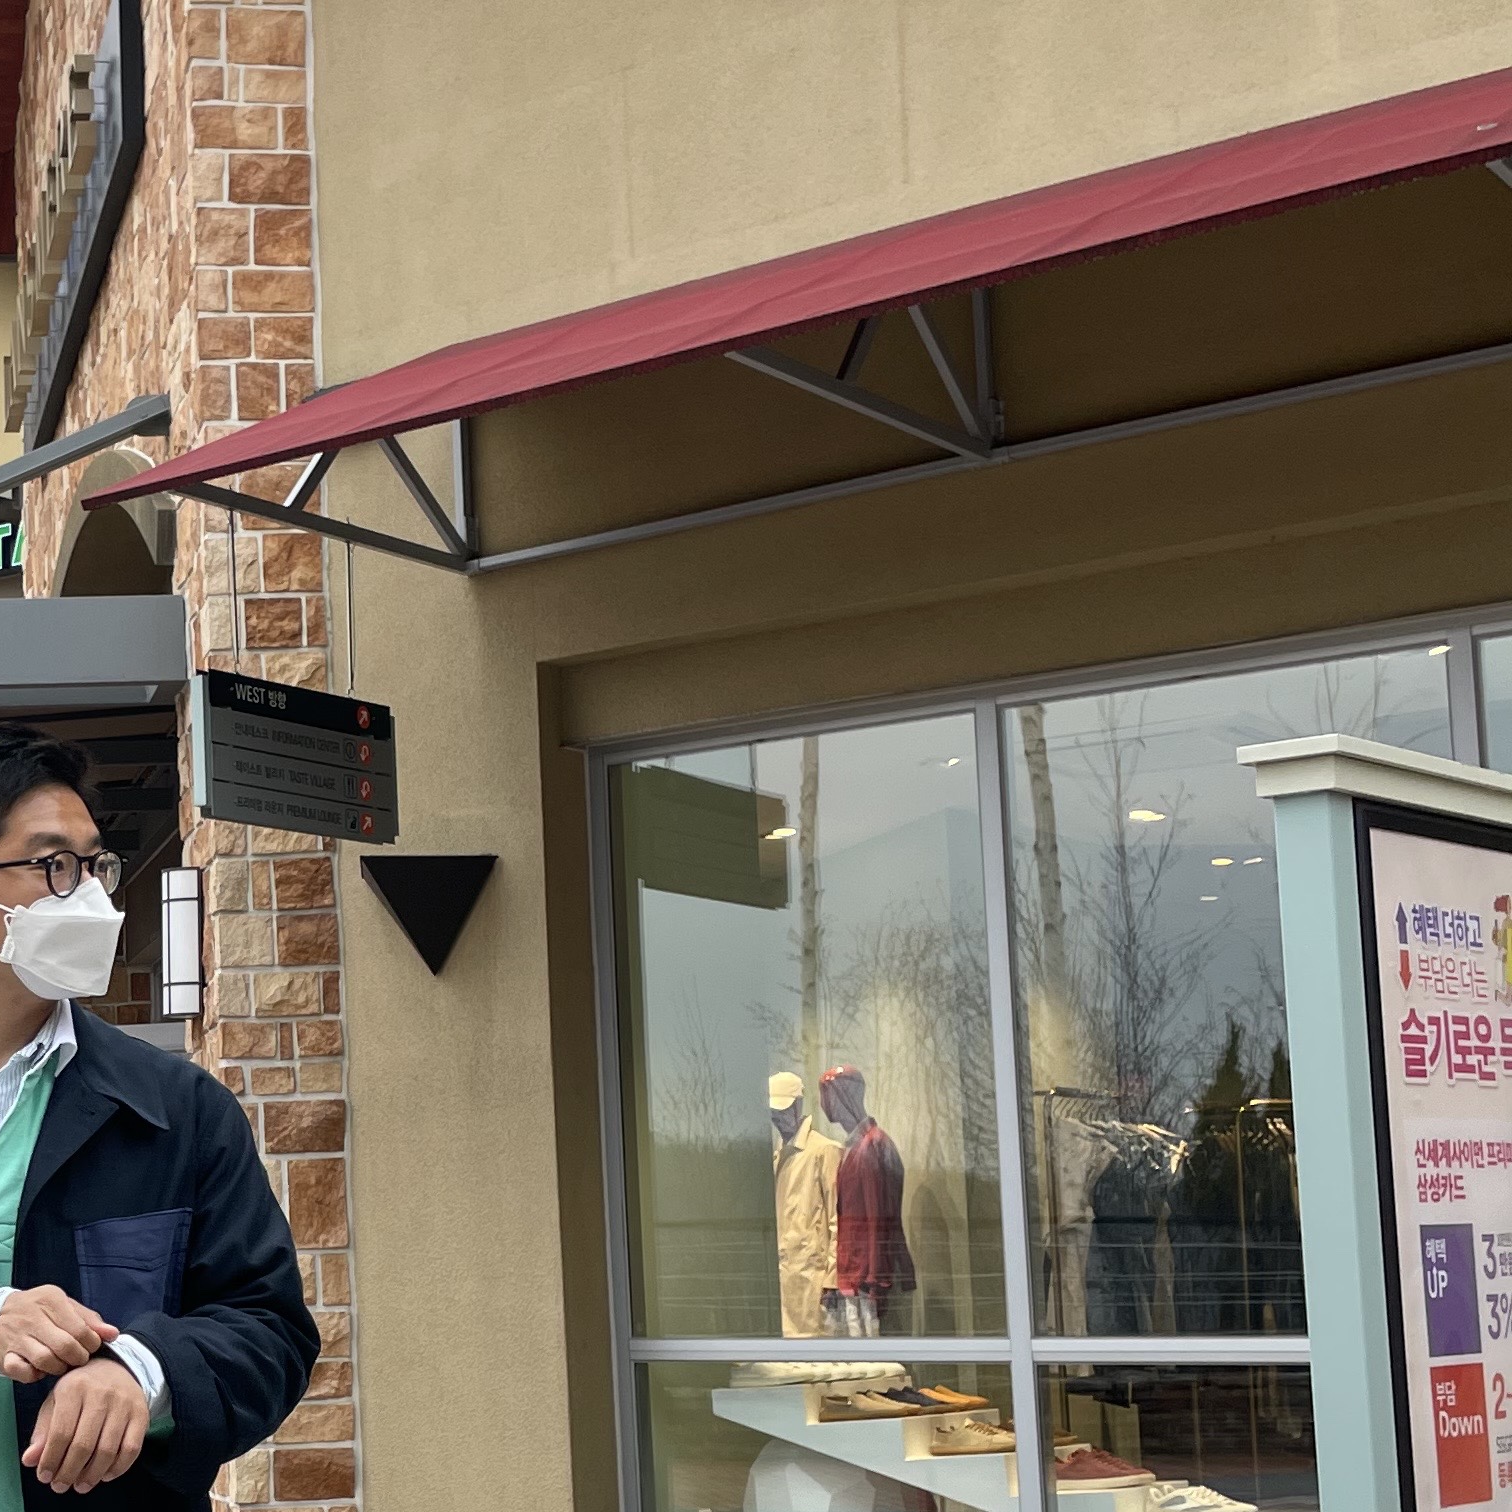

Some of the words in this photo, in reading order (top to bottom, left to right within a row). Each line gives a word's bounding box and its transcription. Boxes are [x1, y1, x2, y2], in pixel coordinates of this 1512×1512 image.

[234, 682, 266, 705] WEST
[268, 690, 287, 710] 방향
[1411, 903, 1441, 946] 혜택
[1441, 908, 1484, 950] 더하고
[1417, 954, 1459, 994] 부담은
[1460, 959, 1488, 998] 더는
[1417, 1172, 1467, 1203] 삼성카드
[1427, 1266, 1448, 1299] UP
[1435, 1380, 1456, 1408] 부담
[1438, 1410, 1485, 1438] Down
